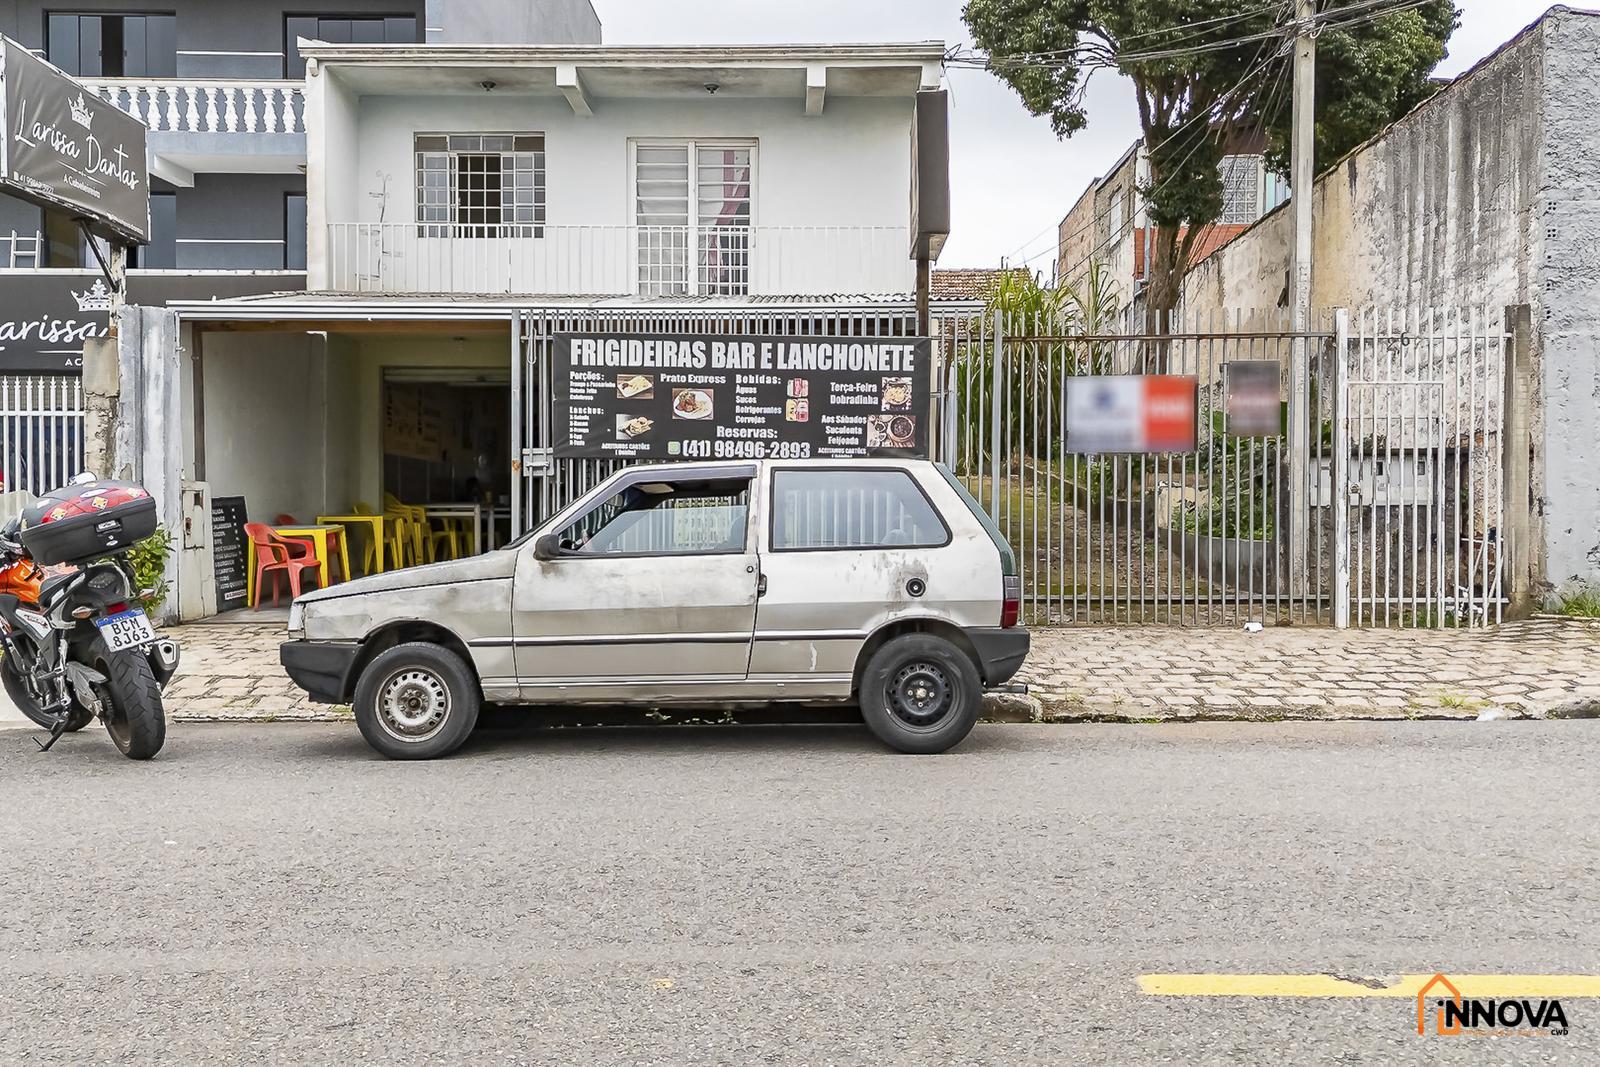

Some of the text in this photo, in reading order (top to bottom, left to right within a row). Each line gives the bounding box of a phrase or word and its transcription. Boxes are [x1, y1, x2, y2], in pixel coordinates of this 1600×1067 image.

[15, 99, 139, 190] Larissa Dantas
[0, 314, 109, 343] arissa
[570, 338, 915, 372] FRIGIDEIRAS BAR E LANCHONETE
[660, 373, 727, 384] Prato Express
[735, 374, 782, 384] Bebidas:
[830, 381, 878, 393] Terça-Feira
[735, 395, 757, 404] Sucos
[830, 394, 879, 405] Dobradinha
[821, 414, 868, 425] Aos Sábados
[716, 426, 778, 439] Reservas:
[825, 425, 863, 435] Suculenta
[828, 436, 859, 446] Feijoada
[682, 440, 811, 459] (41) 98496-2893
[111, 617, 140, 635] BCM
[112, 627, 150, 647] 8J63
